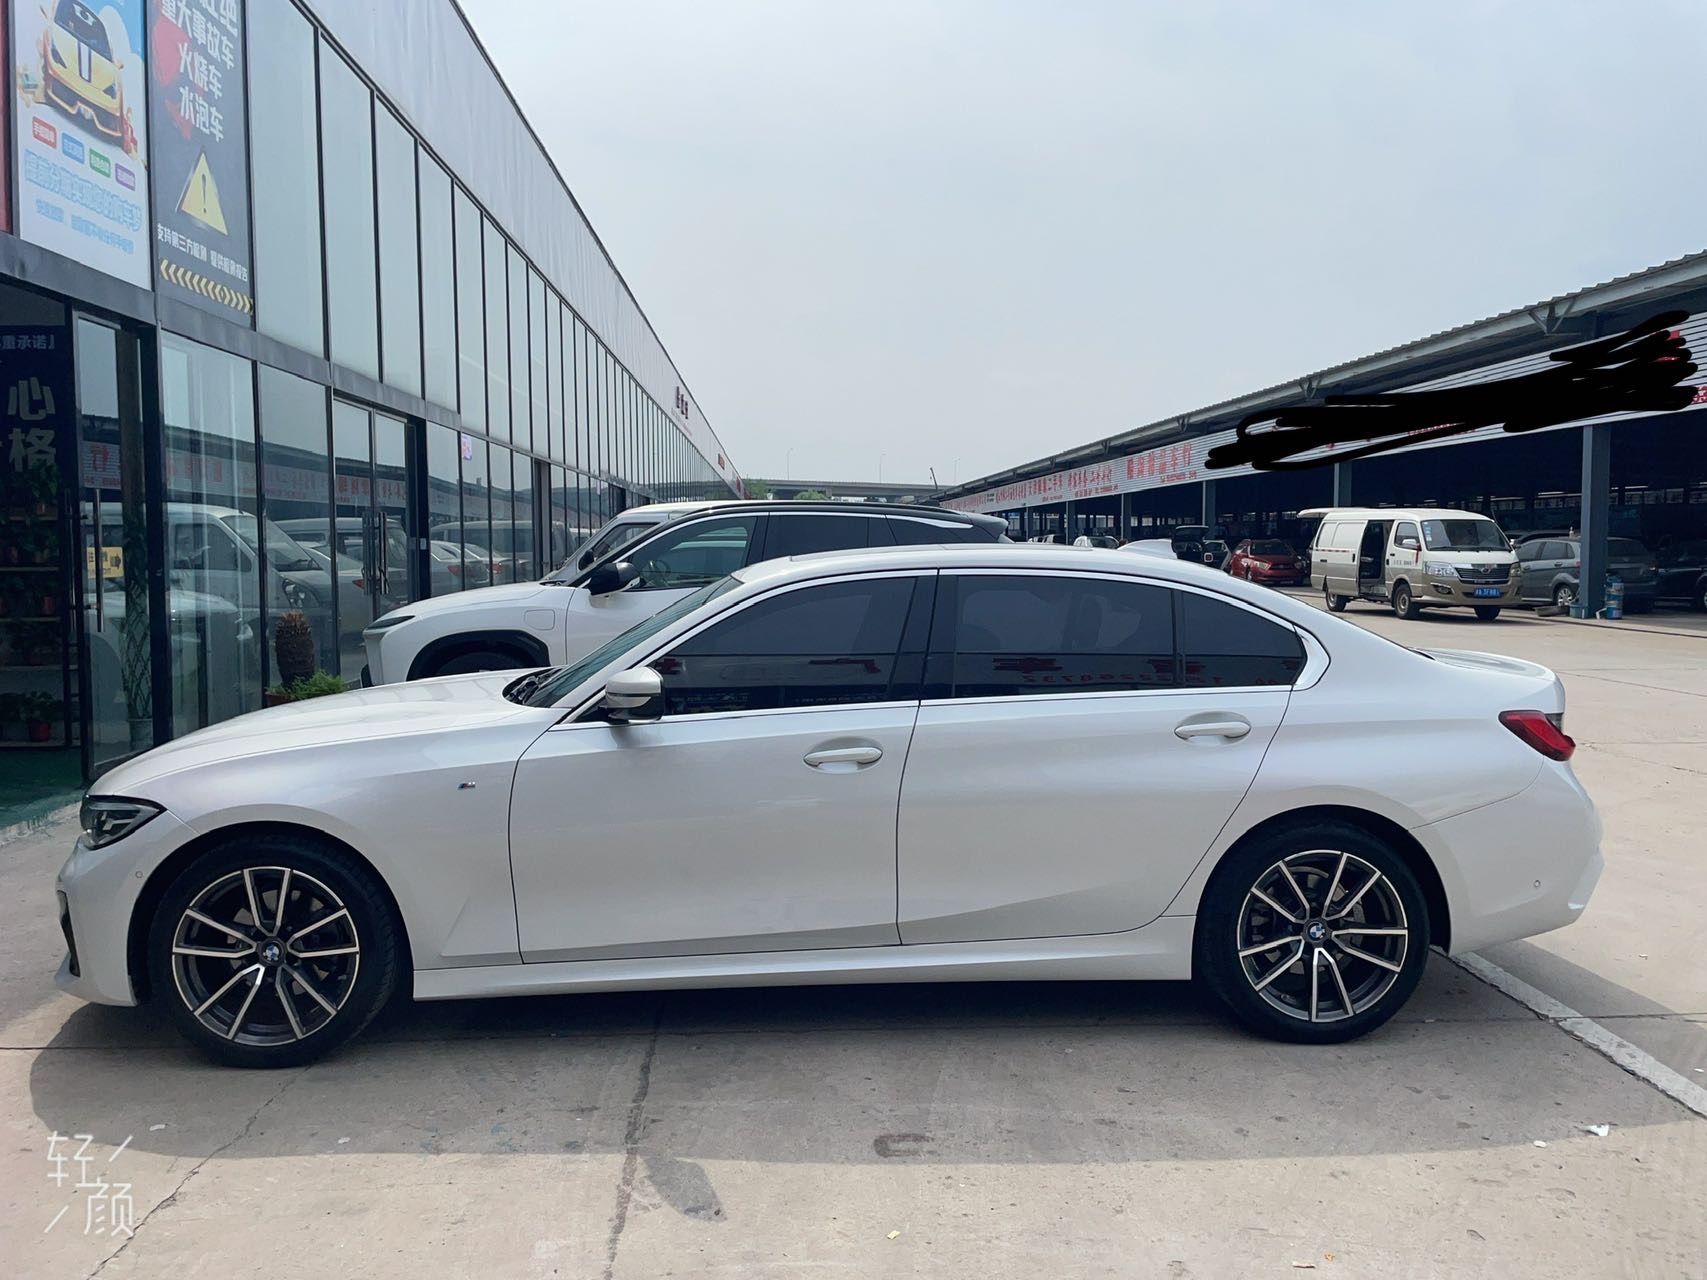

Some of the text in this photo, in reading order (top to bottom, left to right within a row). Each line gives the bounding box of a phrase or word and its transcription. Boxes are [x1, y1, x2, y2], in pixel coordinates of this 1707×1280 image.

[178, 42, 222, 100] 火烧车
[179, 86, 224, 143] 水泡车
